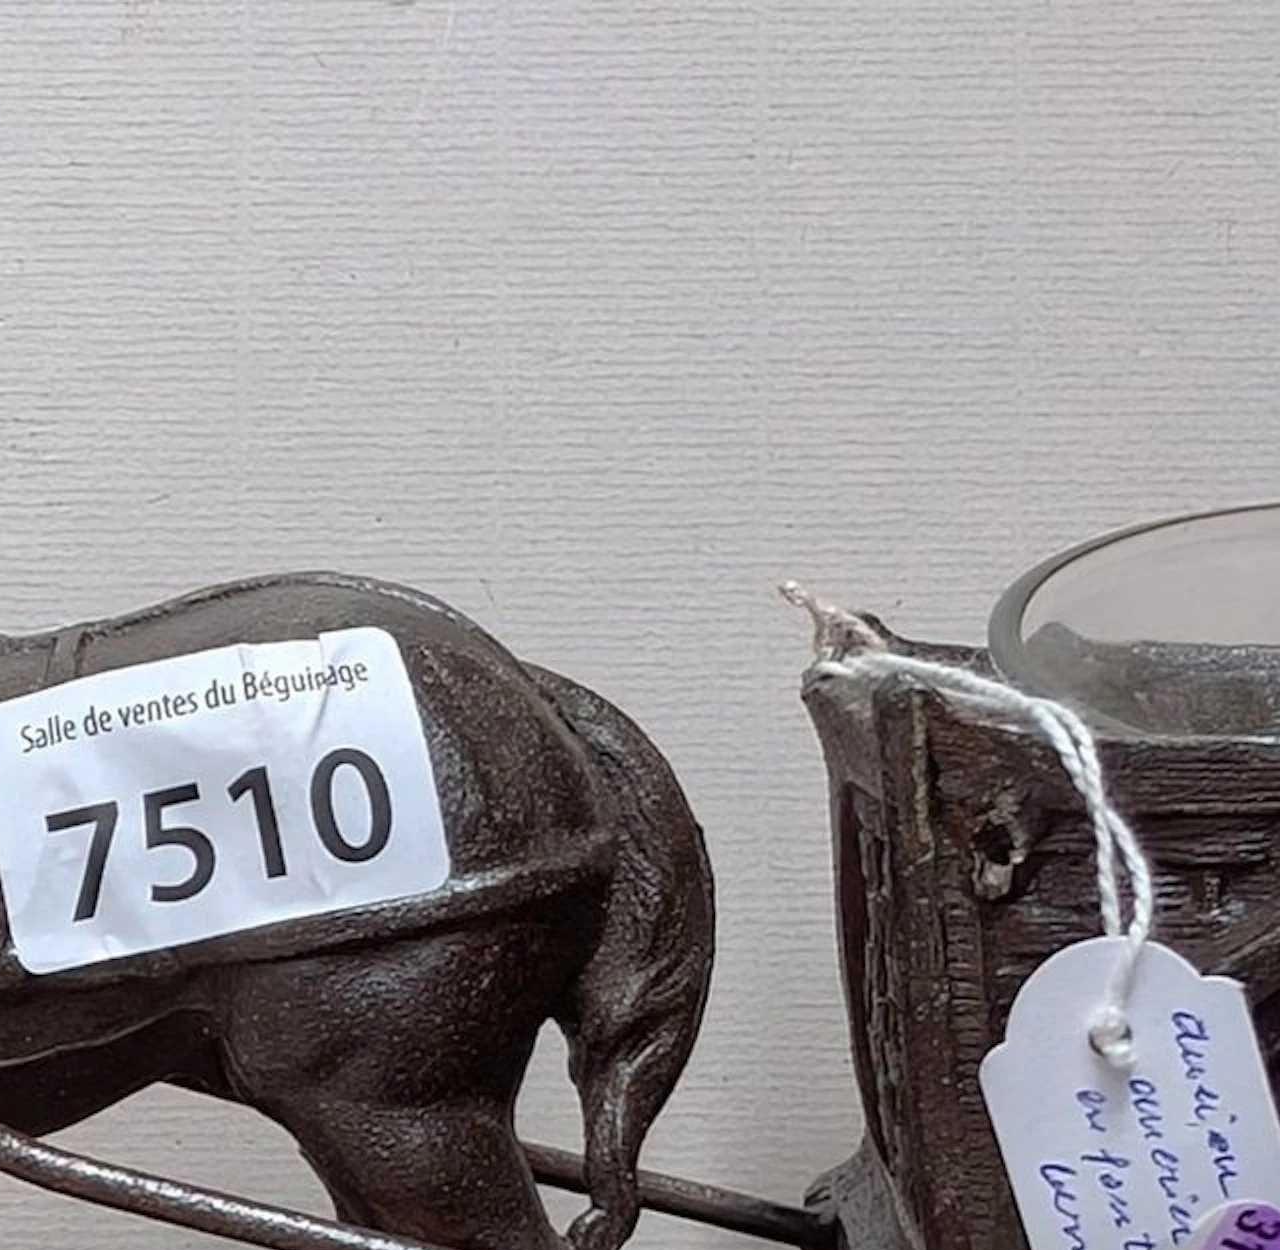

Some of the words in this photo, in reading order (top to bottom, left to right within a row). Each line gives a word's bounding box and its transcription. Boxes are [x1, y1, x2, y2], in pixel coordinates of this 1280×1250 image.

[21, 715, 77, 753] Salle
[84, 705, 113, 738] de
[118, 689, 199, 729] ventes
[205, 679, 238, 711] du
[242, 660, 369, 702] Béguinage
[45, 747, 393, 923] 7510
